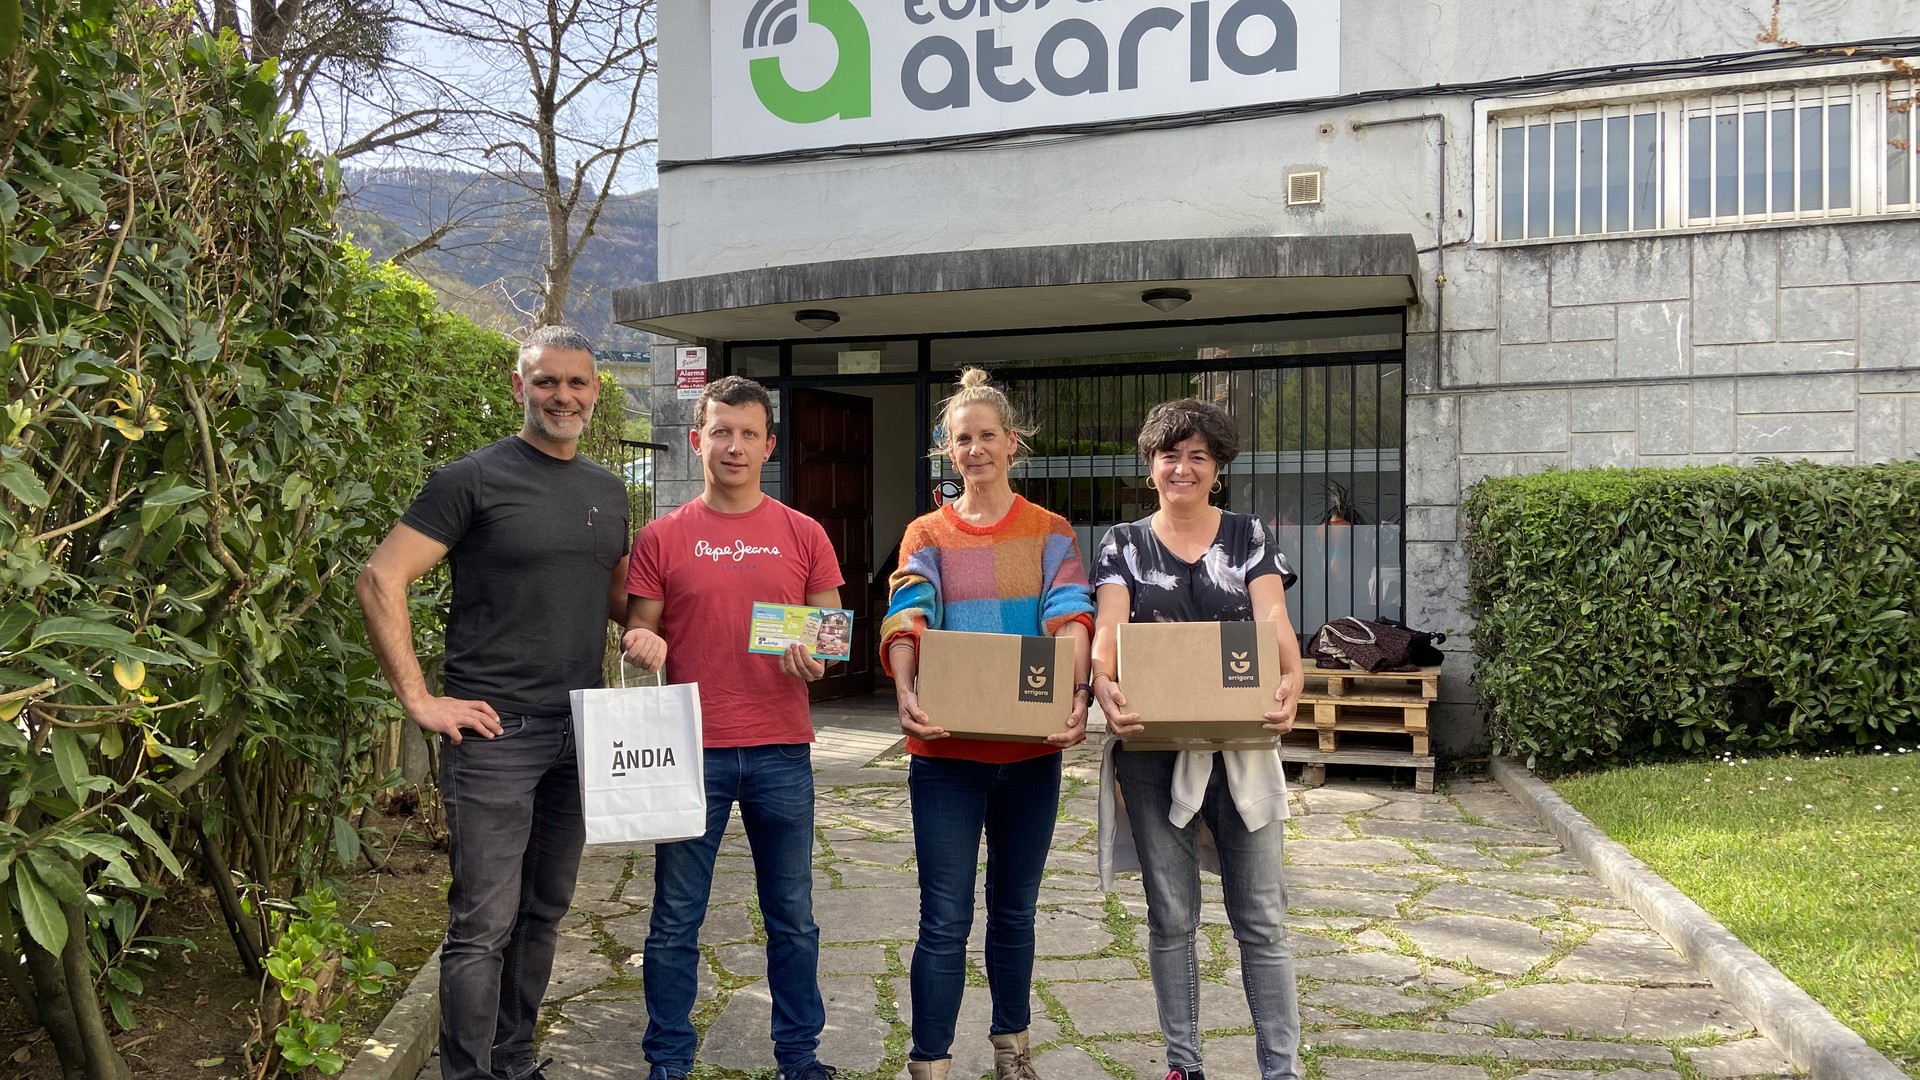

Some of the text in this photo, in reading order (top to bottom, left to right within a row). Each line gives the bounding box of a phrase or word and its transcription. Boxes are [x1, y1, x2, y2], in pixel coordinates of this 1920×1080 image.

[901, 0, 1298, 111] ataria
[695, 540, 733, 561] Pepe
[612, 745, 676, 771] ANDIA
